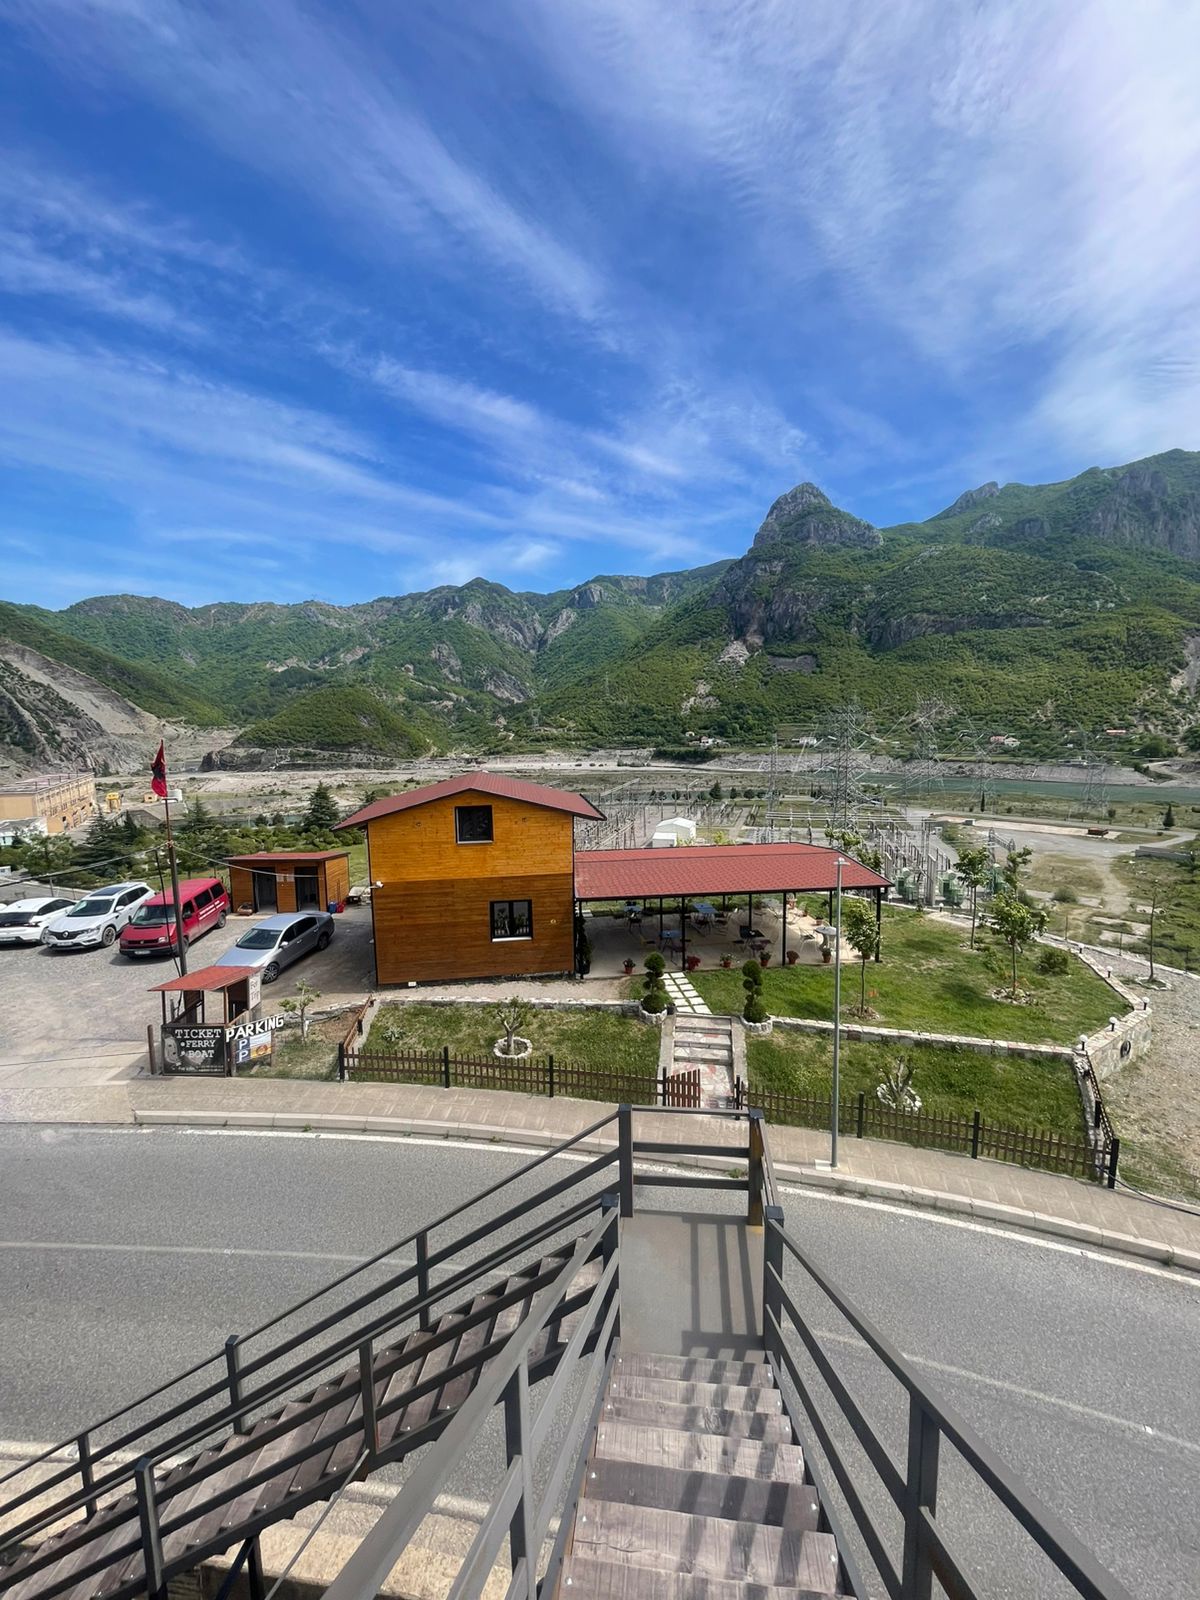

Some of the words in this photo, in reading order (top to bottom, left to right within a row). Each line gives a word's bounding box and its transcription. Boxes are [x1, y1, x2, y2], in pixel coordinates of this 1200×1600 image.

[174, 1028, 222, 1039] TICKET
[225, 1015, 284, 1042] PARKING
[186, 1040, 216, 1048] FERRY
[238, 1038, 248, 1050] P
[187, 1050, 215, 1058] BOAT
[238, 1050, 249, 1062] P
